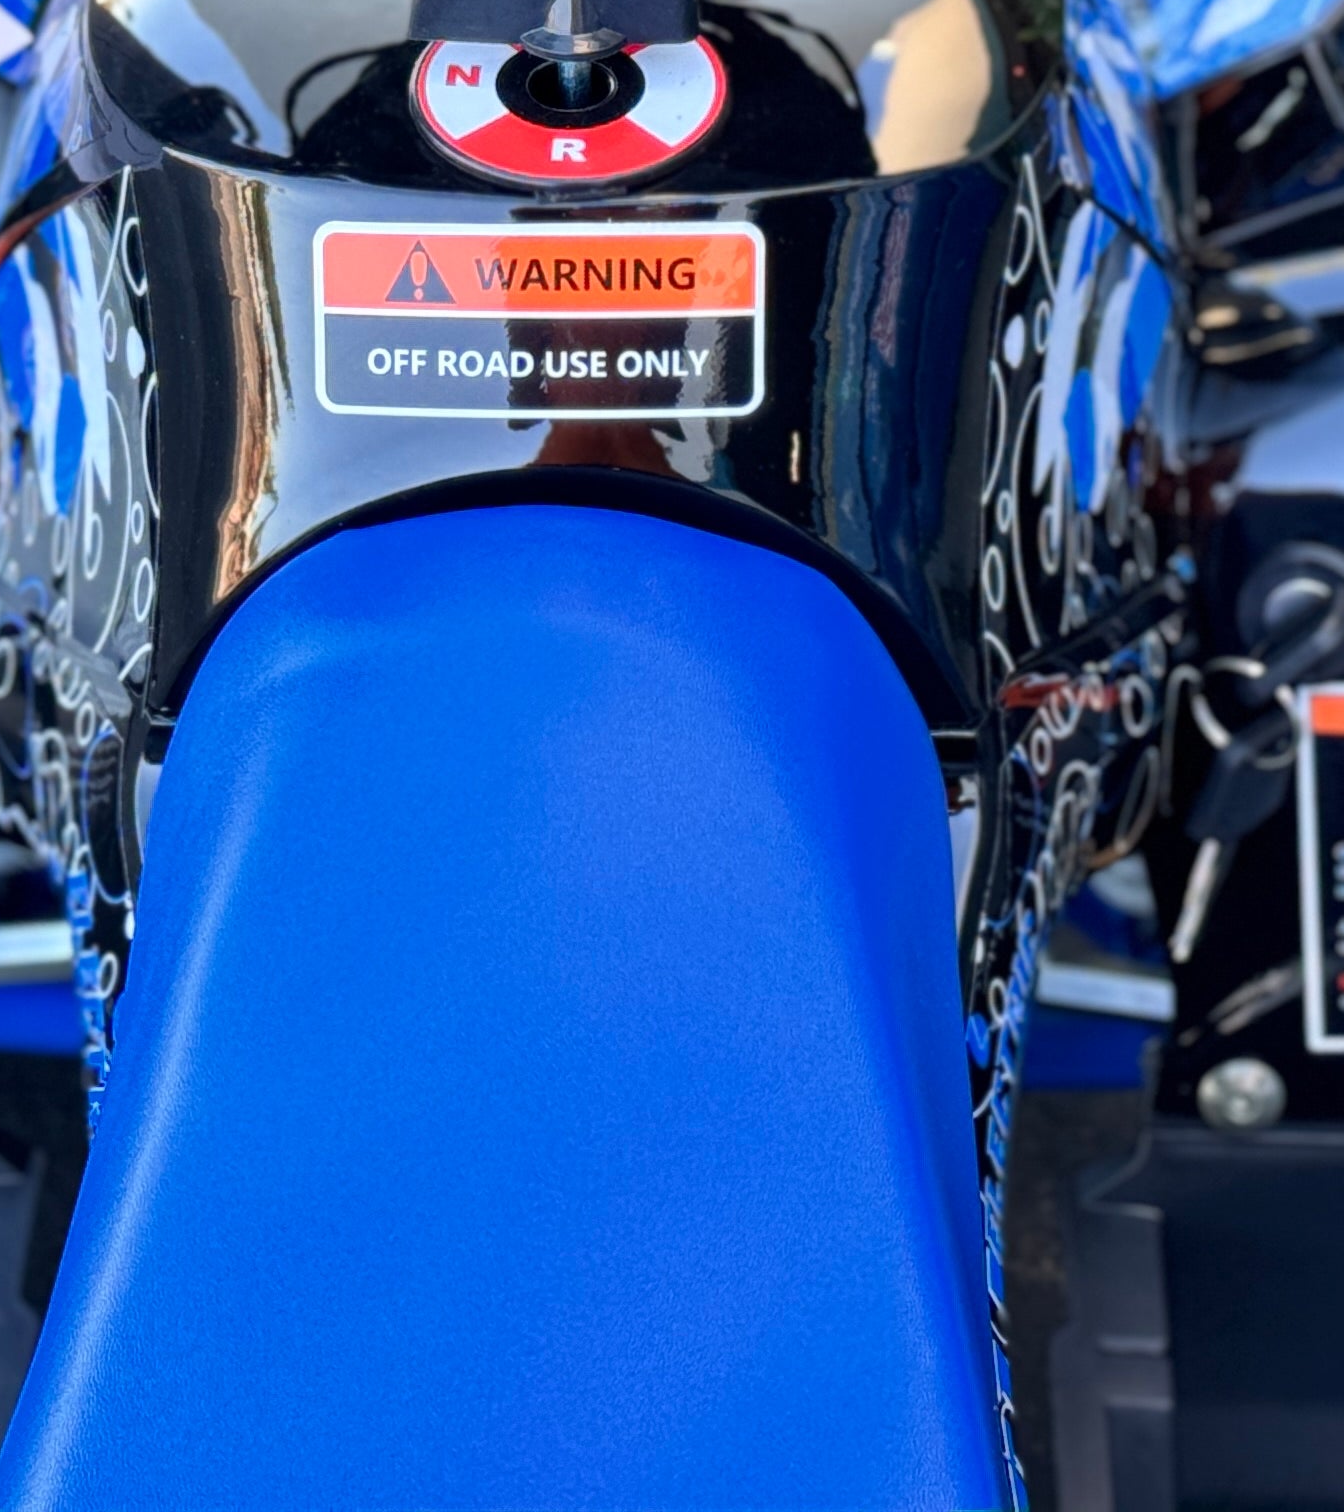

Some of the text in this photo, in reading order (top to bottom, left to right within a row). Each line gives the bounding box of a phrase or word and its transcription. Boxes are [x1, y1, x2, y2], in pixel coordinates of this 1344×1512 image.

[445, 64, 482, 88] N
[550, 137, 587, 163] R
[475, 257, 697, 292] WARNING
[367, 347, 710, 378] OFF ROAD USE ONLY
